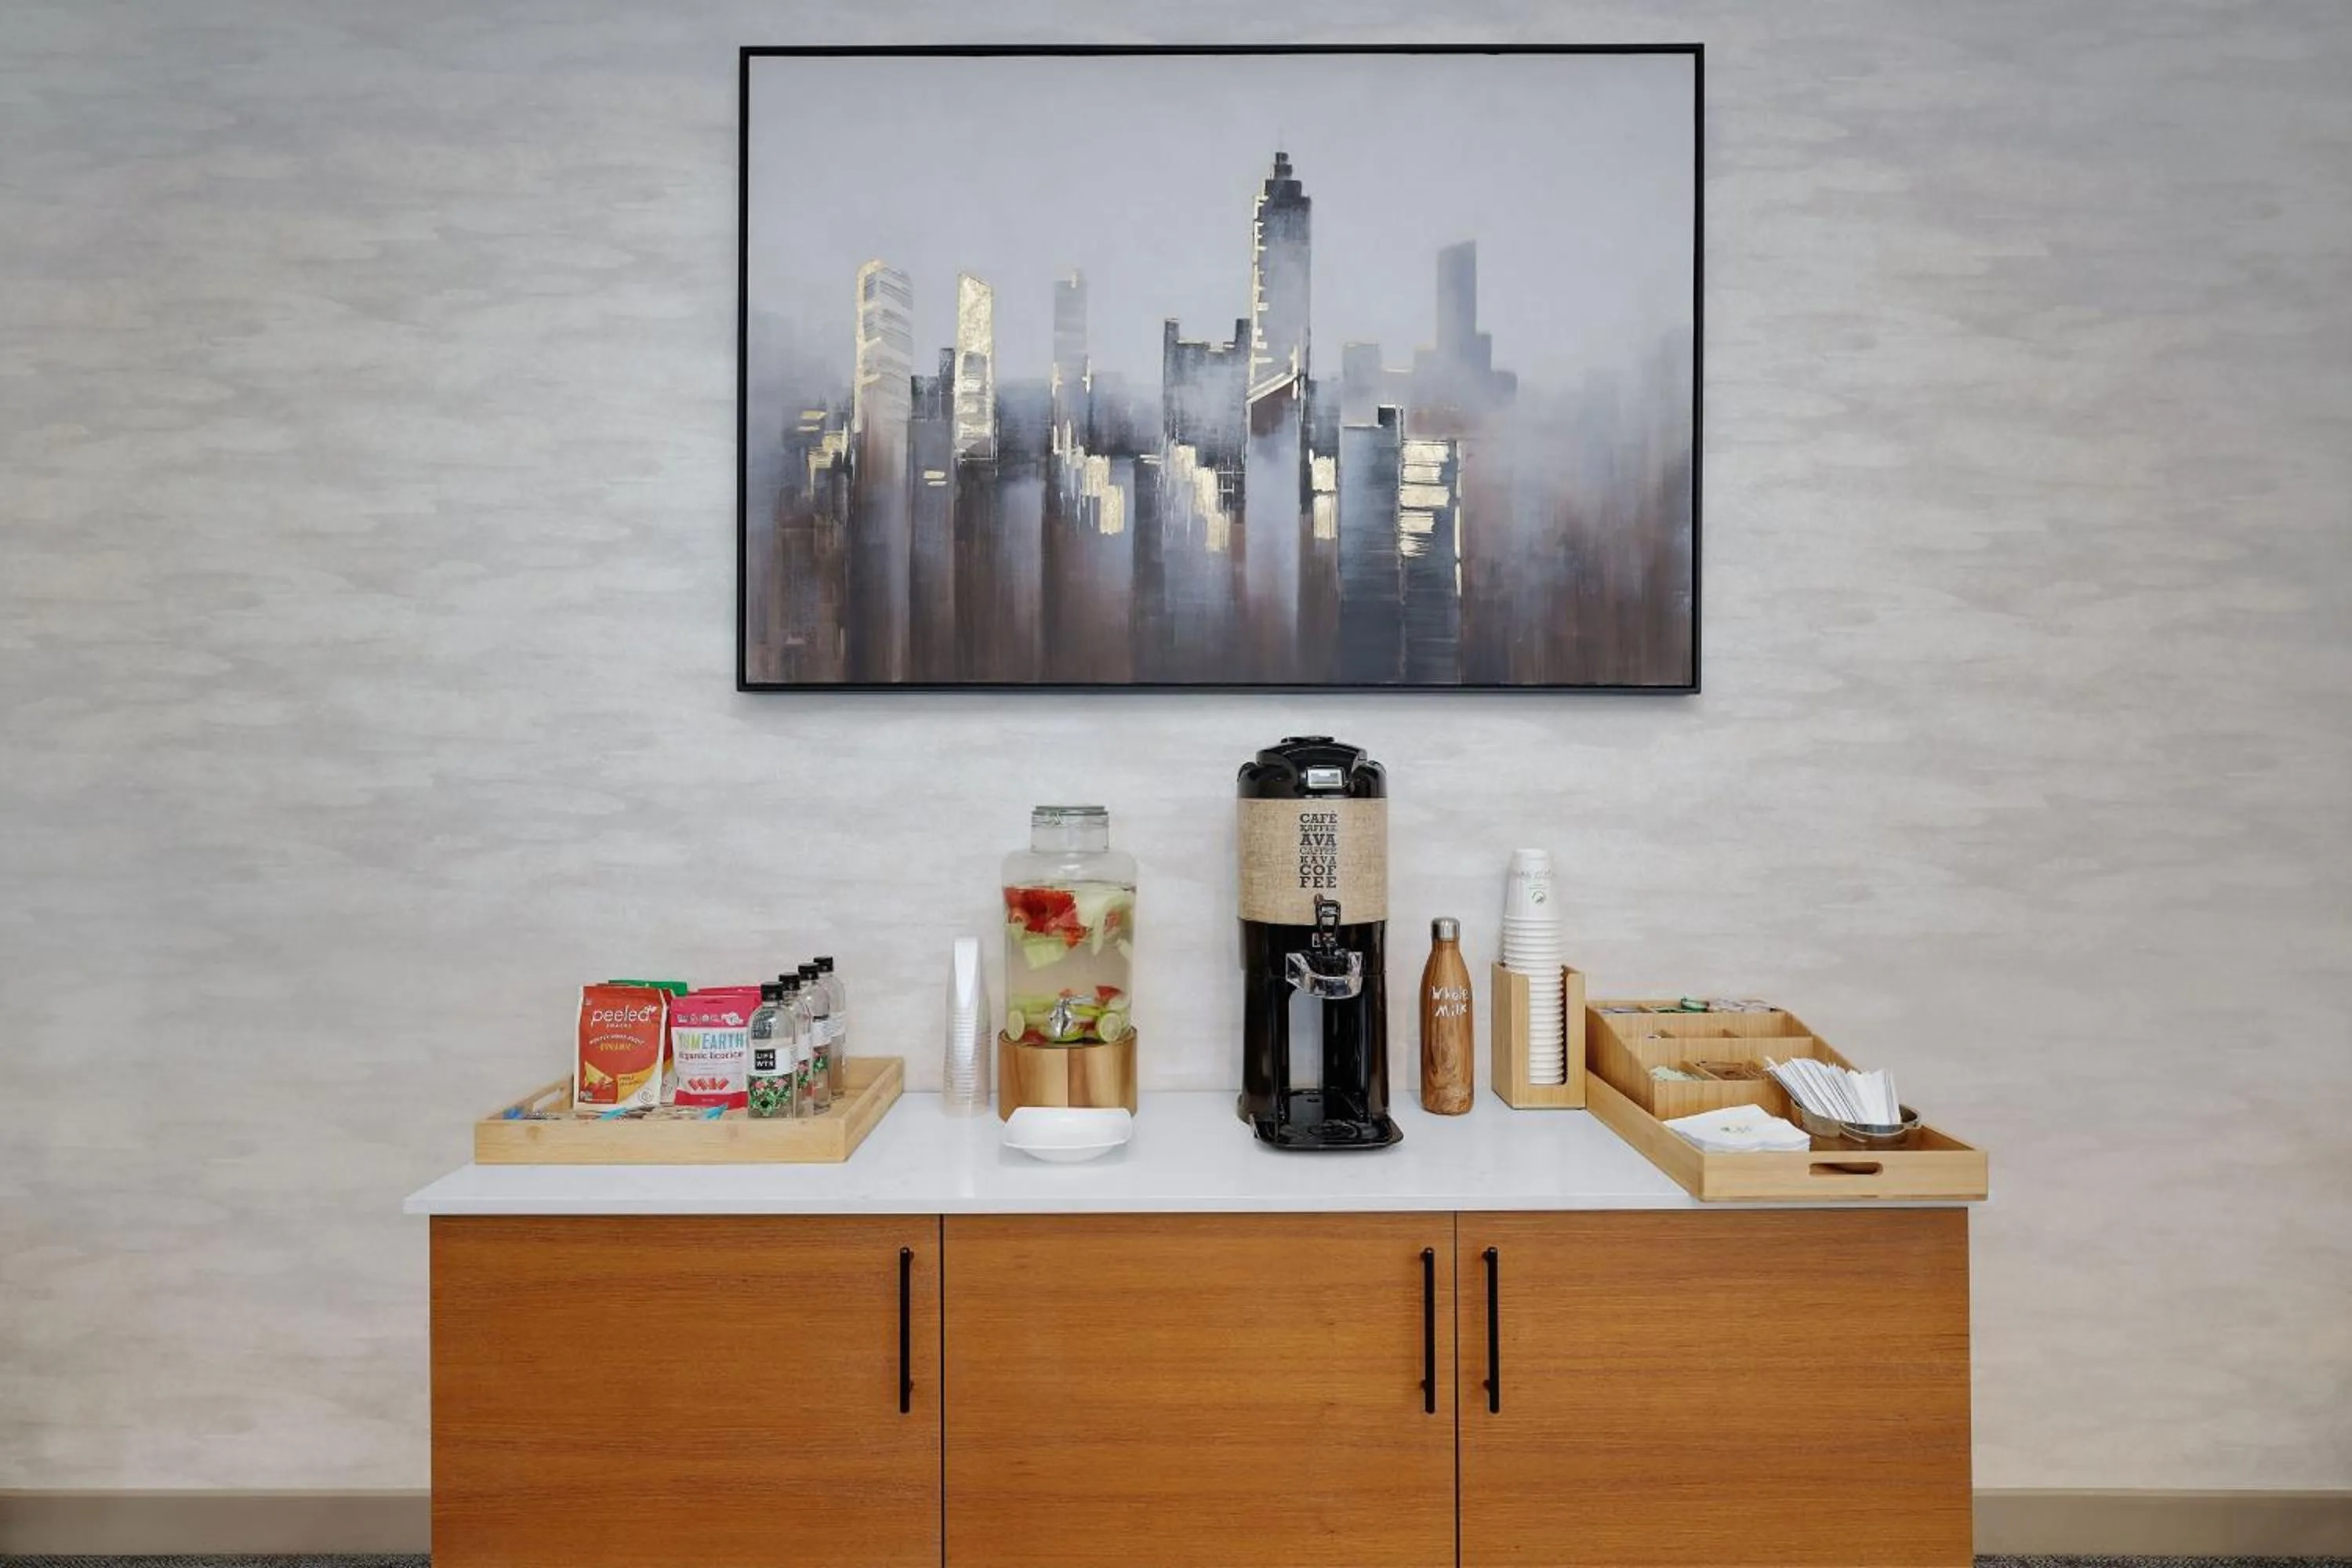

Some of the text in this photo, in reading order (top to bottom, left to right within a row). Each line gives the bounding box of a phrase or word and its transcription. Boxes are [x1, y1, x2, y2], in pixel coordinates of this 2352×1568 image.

[1299, 811, 1338, 823] CAFÉ
[1299, 834, 1338, 846] AVA
[1299, 865, 1337, 876] COF
[1299, 877, 1337, 888] FEE
[590, 1004, 655, 1029] peeled
